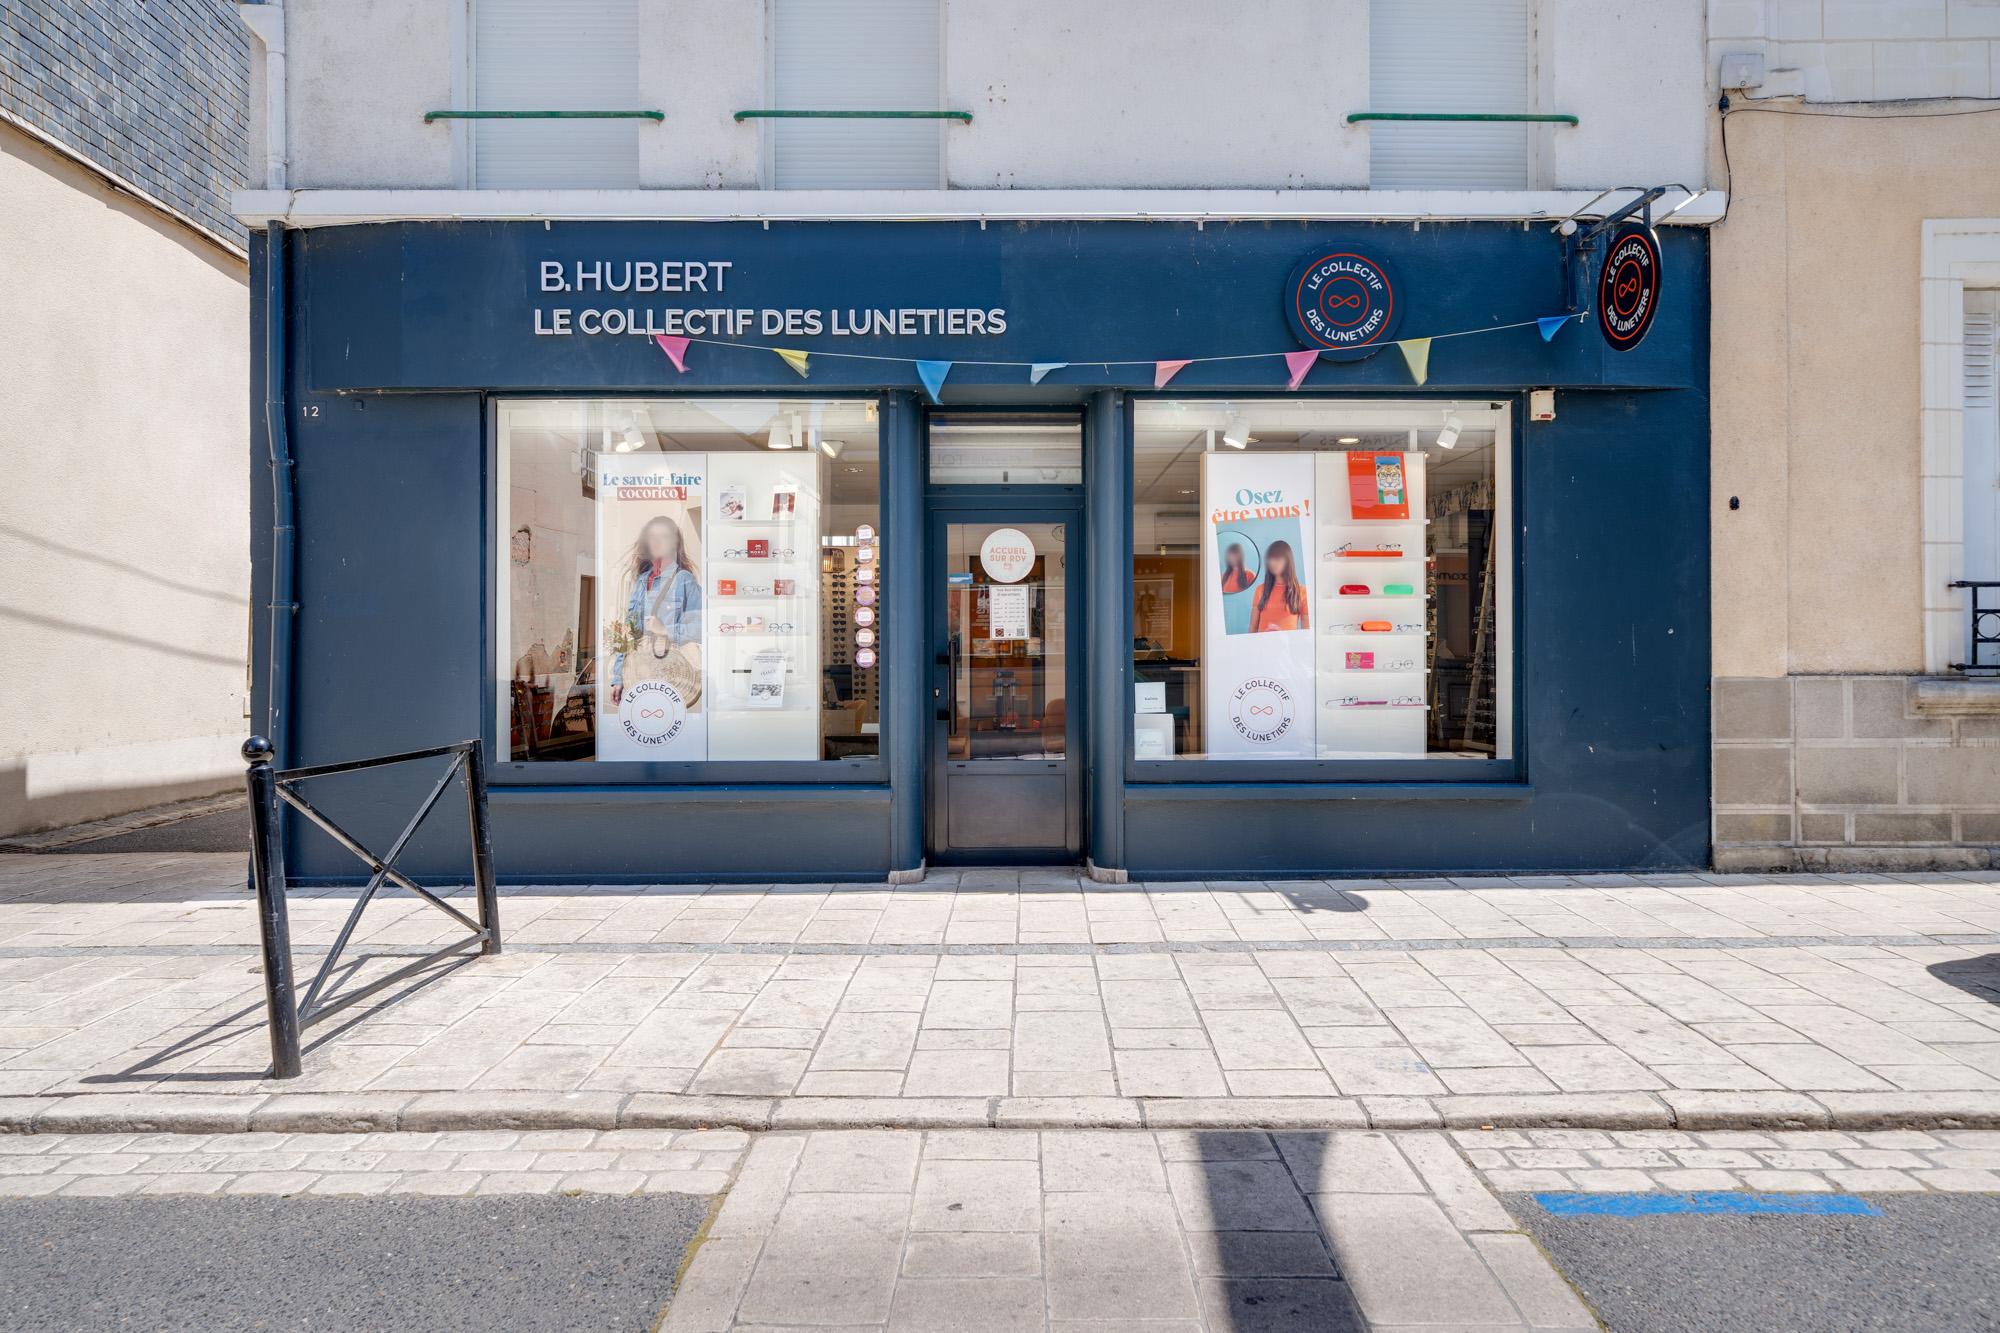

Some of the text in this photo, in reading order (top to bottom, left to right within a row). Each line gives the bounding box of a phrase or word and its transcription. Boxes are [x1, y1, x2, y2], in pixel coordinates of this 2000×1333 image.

[1307, 261, 1383, 291] LE COLLECTIF
[1607, 243, 1650, 284] LE COLLECTIF
[540, 261, 733, 293] B.HUBERT
[535, 309, 1007, 336] LE COLLECTIF DES LUNETIERS
[1607, 288, 1650, 332] DES LUNETIERS
[1306, 308, 1383, 341] DES LUNETIERS
[603, 473, 702, 486] Le savoir-faire
[1235, 488, 1283, 506] Osez
[990, 547, 1027, 555] ACCUEIL
[625, 682, 681, 704] LE COLLECTIF
[1234, 680, 1290, 701] LE COLLECTIF
[623, 719, 682, 745] DES LUNETIERS
[1232, 716, 1291, 742] DES LUNETIERS
